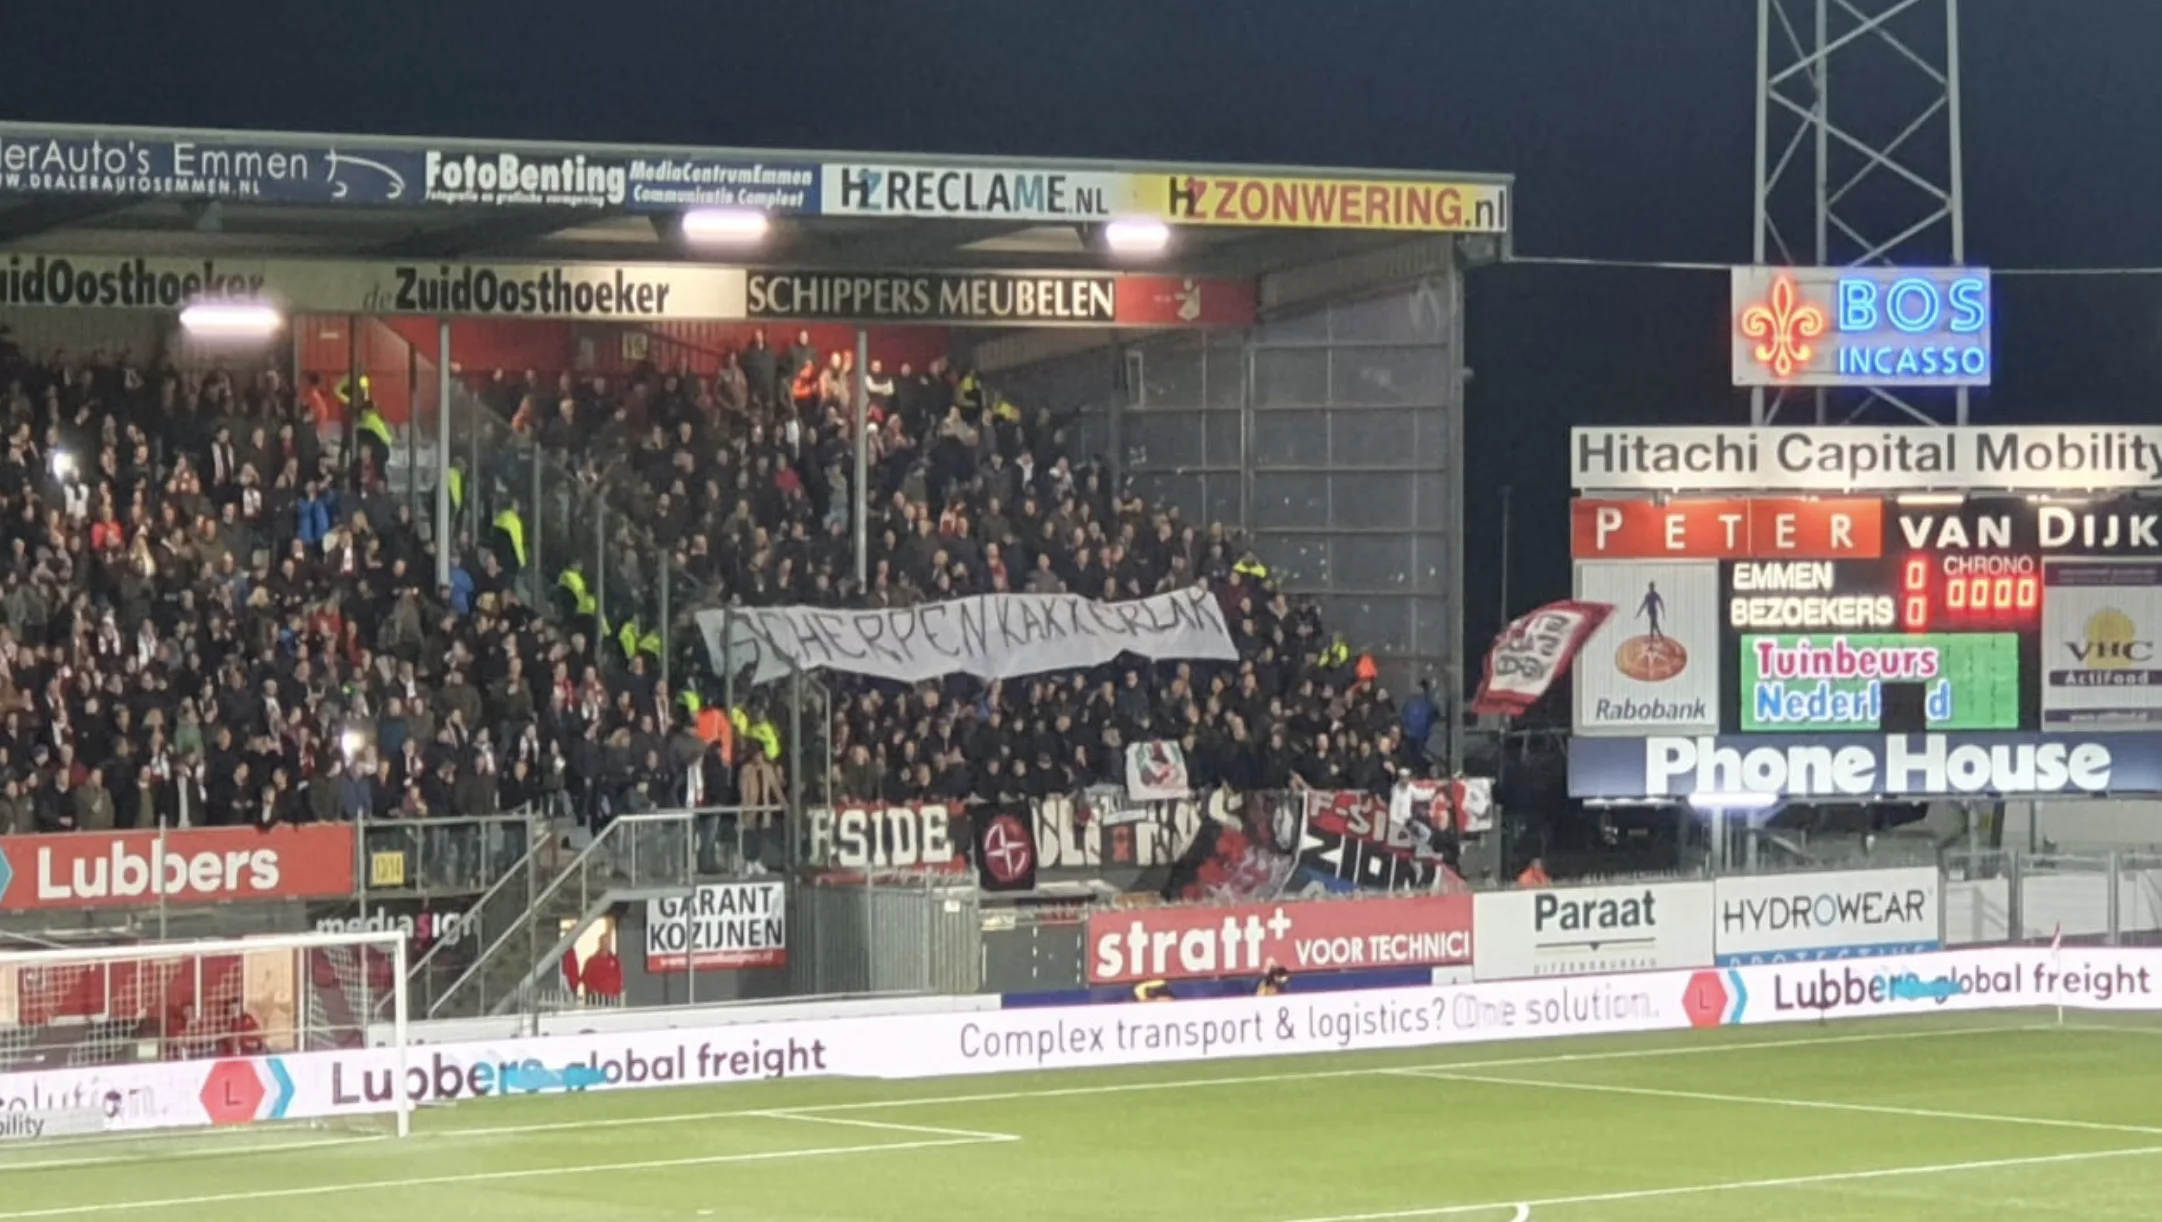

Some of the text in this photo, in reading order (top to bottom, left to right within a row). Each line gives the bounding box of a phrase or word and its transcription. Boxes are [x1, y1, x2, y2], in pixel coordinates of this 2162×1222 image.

[174, 142, 308, 179] Emmen
[426, 151, 625, 204] FotoBenting
[738, 187, 804, 210] Compleet
[1214, 180, 1506, 229] ZONWERING.nl
[395, 266, 670, 314] ZuidOosthoeker
[748, 275, 1115, 318] SCHIPPERS MEUBELEN
[1836, 276, 1986, 333] BOS
[1838, 345, 1986, 375] INCASSO
[1579, 433, 1758, 473] Hitachi
[1776, 433, 1956, 480] Capital
[1596, 507, 1853, 550] PETER
[1732, 560, 1927, 591] EMMEN 0
[1943, 555, 2034, 575] CHRONO
[1731, 594, 1927, 627] BEZOEKERS 0
[1755, 637, 1939, 678] Tuinbeurs
[2063, 640, 2154, 662] VHC
[1595, 697, 1707, 722] Rabobank
[1755, 681, 1951, 721] Nederld
[1645, 734, 2112, 795] Phone House
[37, 838, 280, 899] Lubbers
[658, 886, 774, 918] GARANT
[1534, 889, 1657, 932] Paraat
[1723, 889, 1926, 933] HYDROWEAR
[651, 918, 783, 950] KOZIJNEN
[1295, 931, 1470, 966] VOOR TECHNICI
[2032, 961, 2152, 1000] freight
[959, 1020, 1105, 1064] Complex
[1116, 1012, 1265, 1057] transport
[1275, 1007, 1296, 1042] &
[1307, 996, 1446, 1048] logistics?
[1525, 982, 1661, 1024] solution.
[696, 1037, 828, 1081] freight
